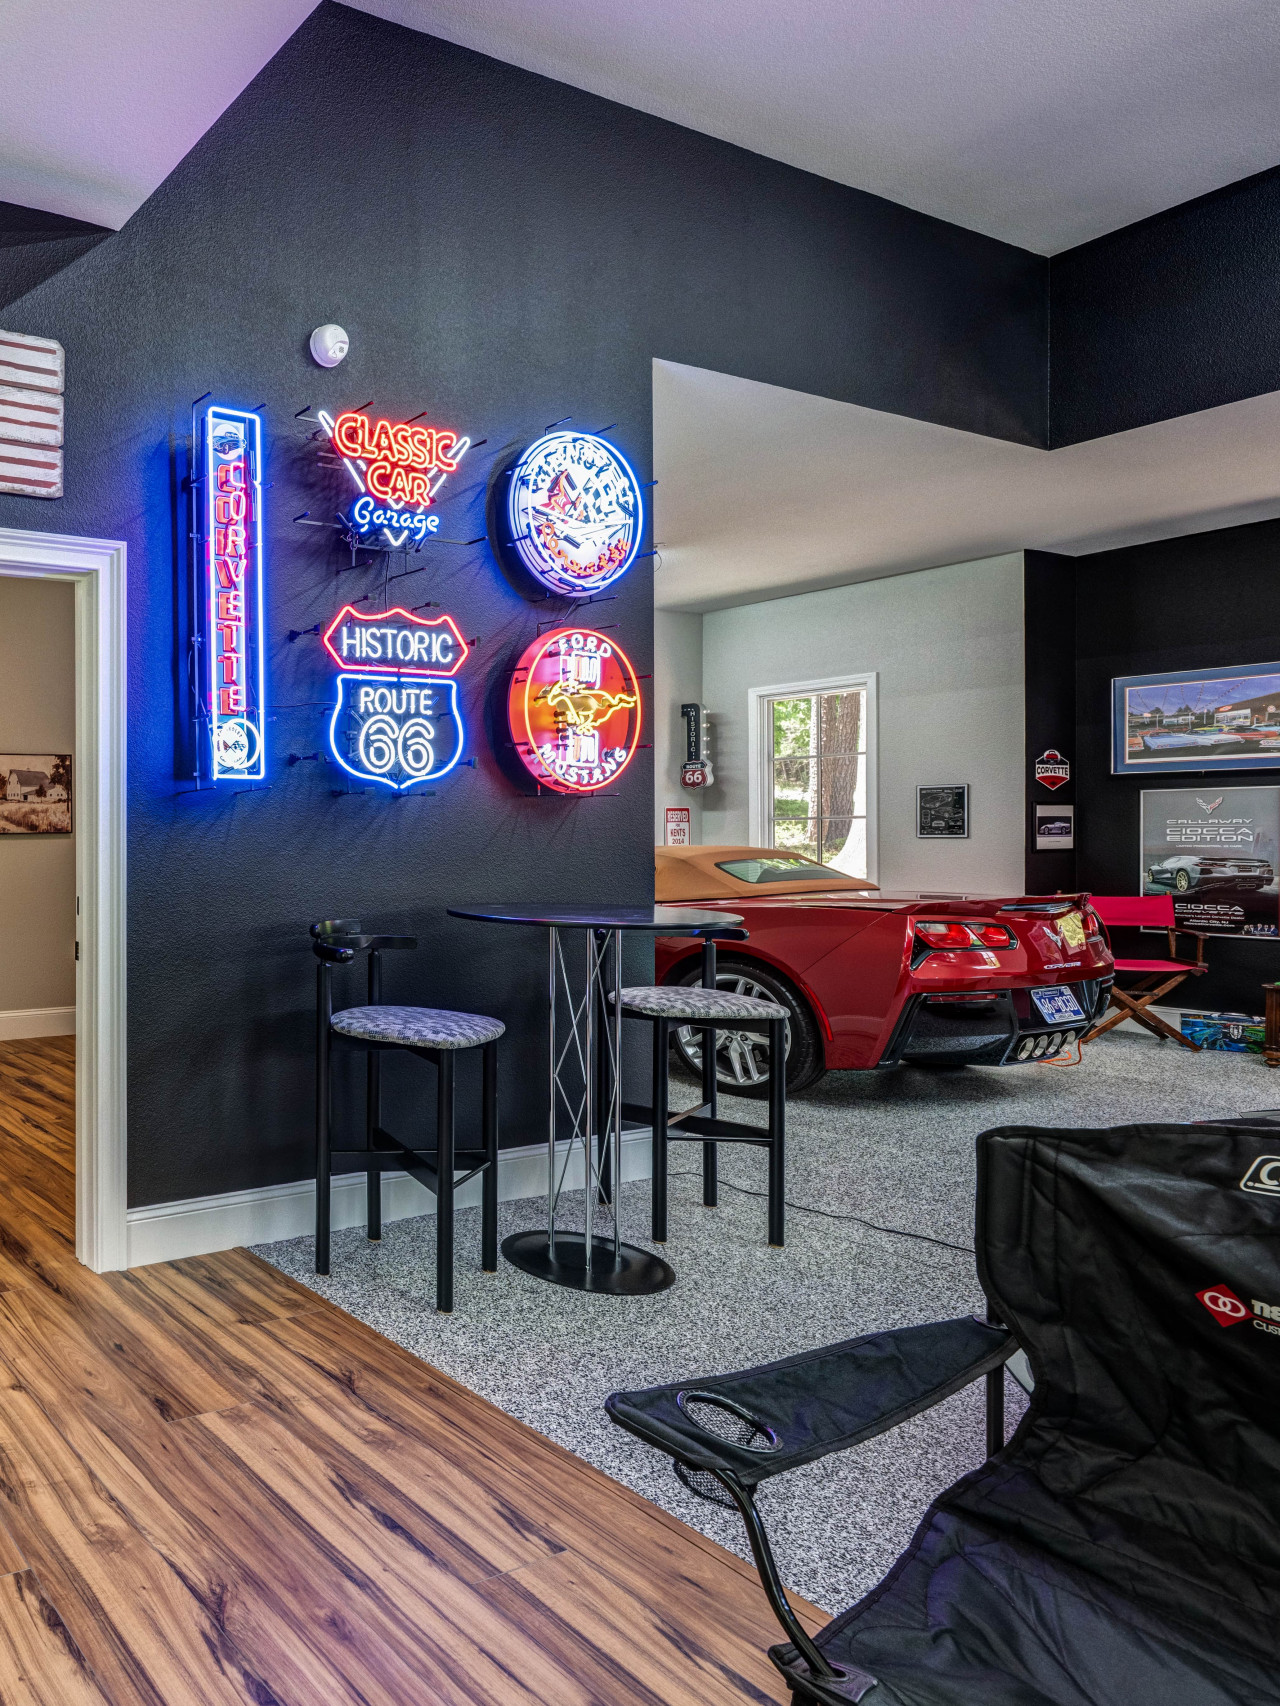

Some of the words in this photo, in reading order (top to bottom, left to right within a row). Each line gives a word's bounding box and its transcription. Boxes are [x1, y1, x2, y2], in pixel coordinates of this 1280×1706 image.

[334, 413, 457, 471] CLASSIC
[367, 461, 431, 506] CAR
[354, 496, 440, 540] Garage
[215, 461, 246, 716] CORVETTE
[342, 626, 453, 663] HISTORIC
[558, 633, 612, 658] FORD
[359, 687, 432, 715] ROUTE
[359, 714, 435, 776] 66
[540, 743, 627, 784] MUSTANG
[685, 771, 702, 784] 66
[1037, 766, 1069, 776] CORVETTE
[667, 811, 689, 822] RESERVED
[1166, 827, 1253, 835] CIOCCA
[1175, 903, 1244, 912] CIOCCA
